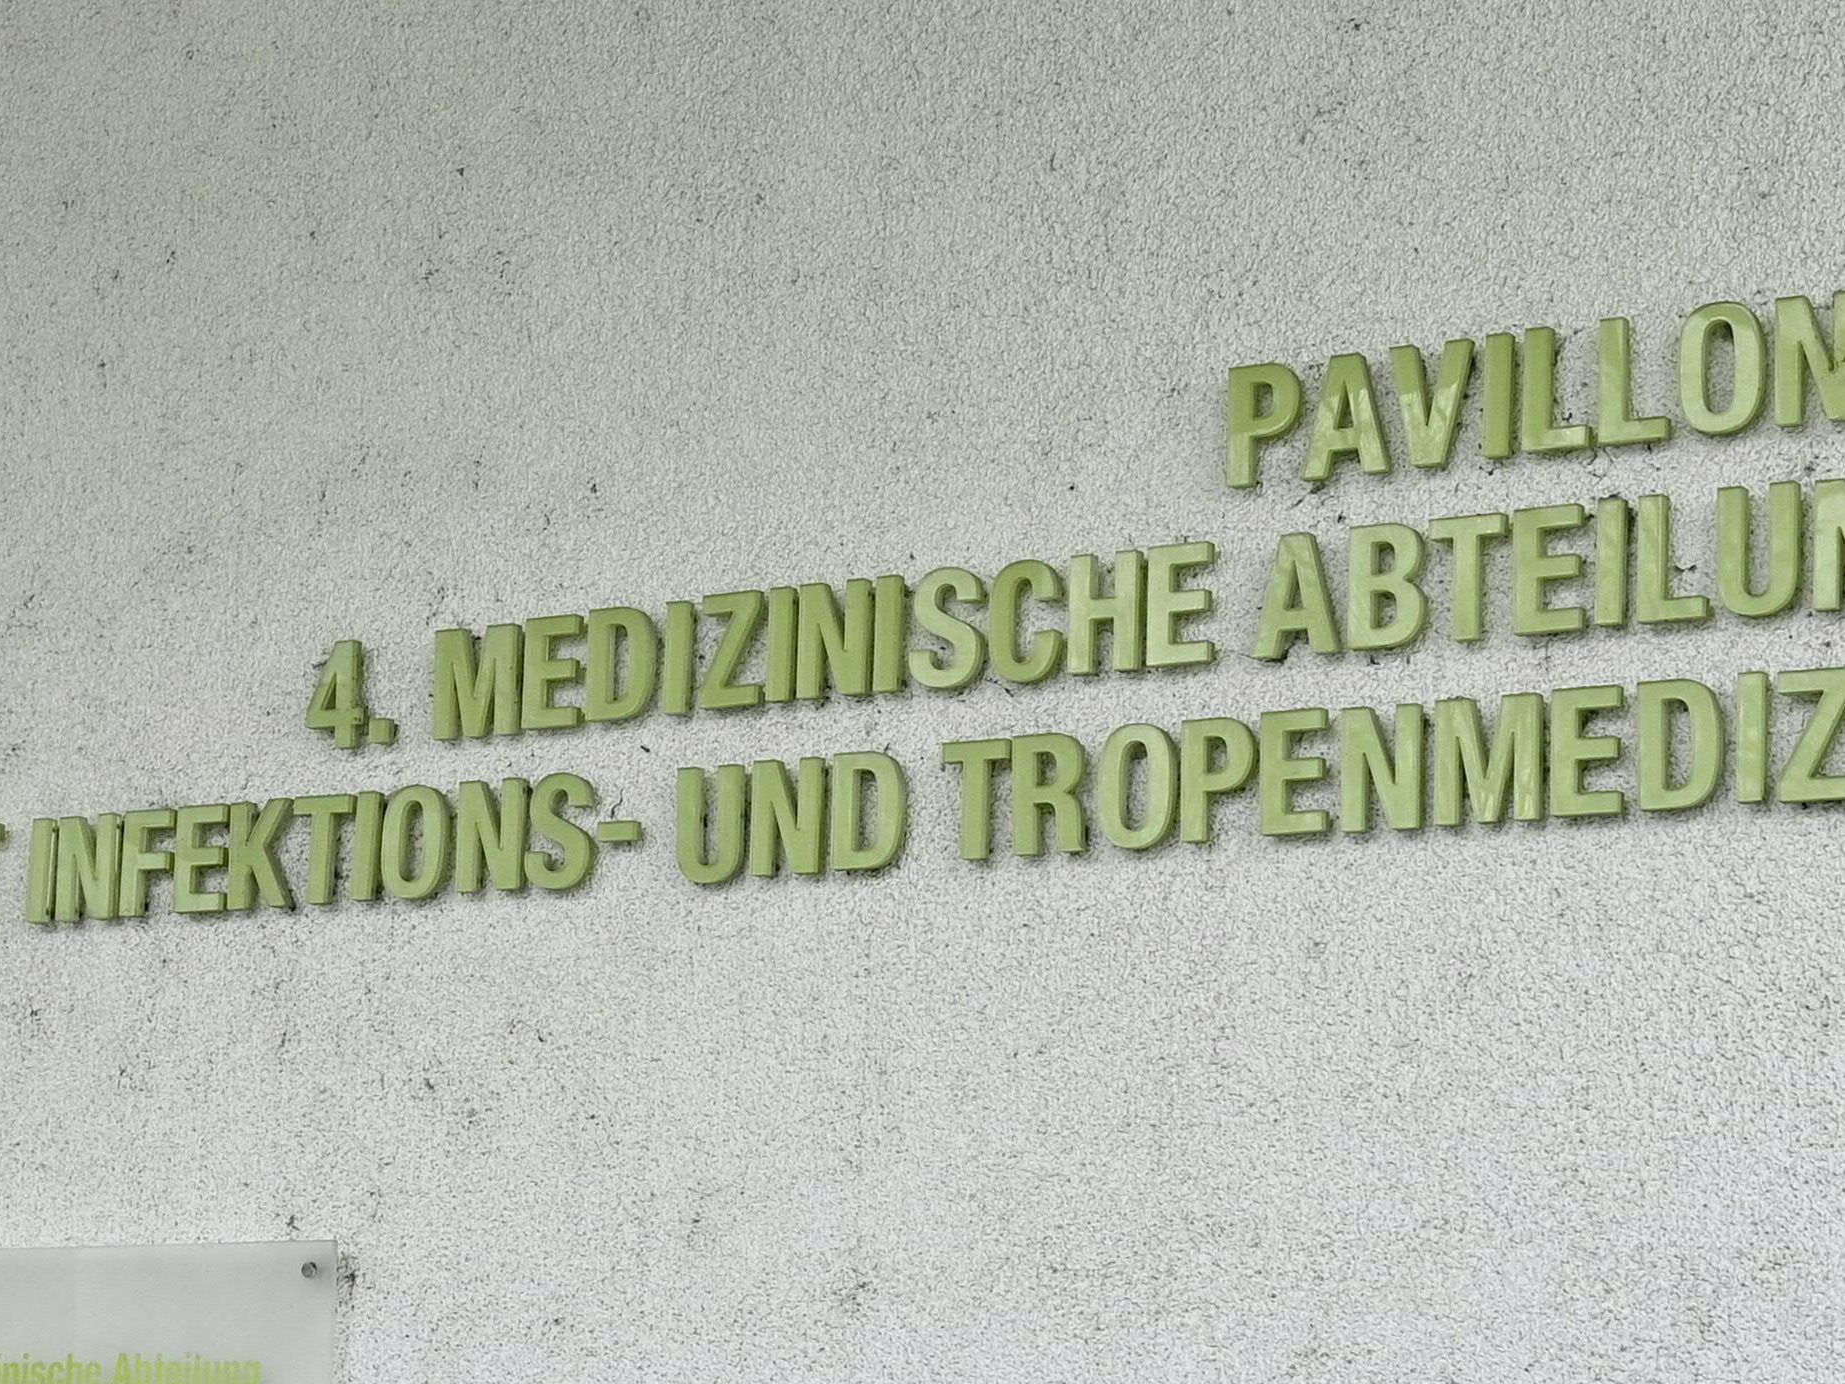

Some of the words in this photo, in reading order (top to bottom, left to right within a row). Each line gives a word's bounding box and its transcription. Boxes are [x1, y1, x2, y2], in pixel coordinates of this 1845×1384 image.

[1225, 288, 1845, 488] PAVILLON
[306, 640, 397, 749] 4.
[433, 541, 1216, 741] MEDIZINISCHE
[25, 772, 643, 924] INFEKTIONS-
[675, 751, 906, 885] UND
[943, 666, 1845, 862] TROPENMEDIZ
